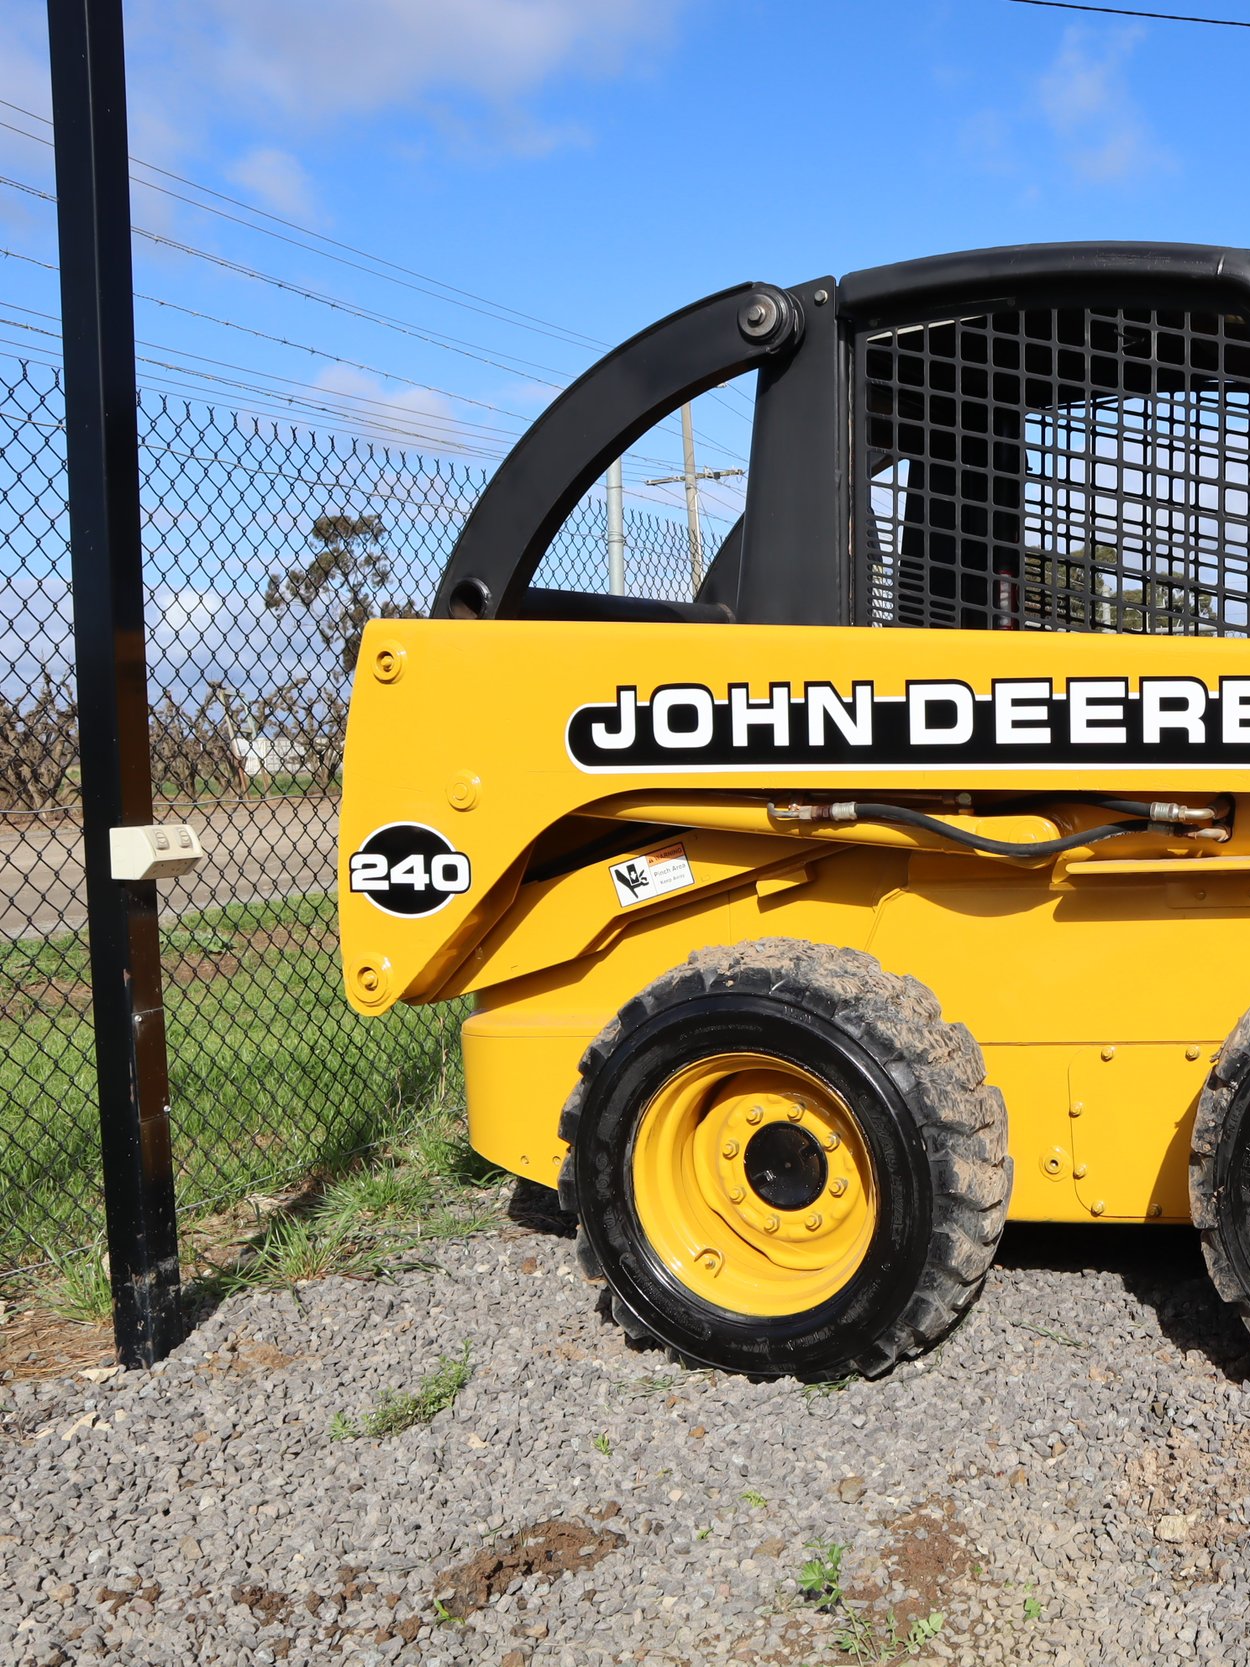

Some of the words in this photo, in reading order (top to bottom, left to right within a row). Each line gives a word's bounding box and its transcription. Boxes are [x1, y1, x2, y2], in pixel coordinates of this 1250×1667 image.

[590, 682, 874, 751] JOHN
[654, 847, 682, 860] WARNING
[350, 853, 470, 892] 240
[654, 868, 671, 877] Pinch
[672, 863, 686, 871] Area
